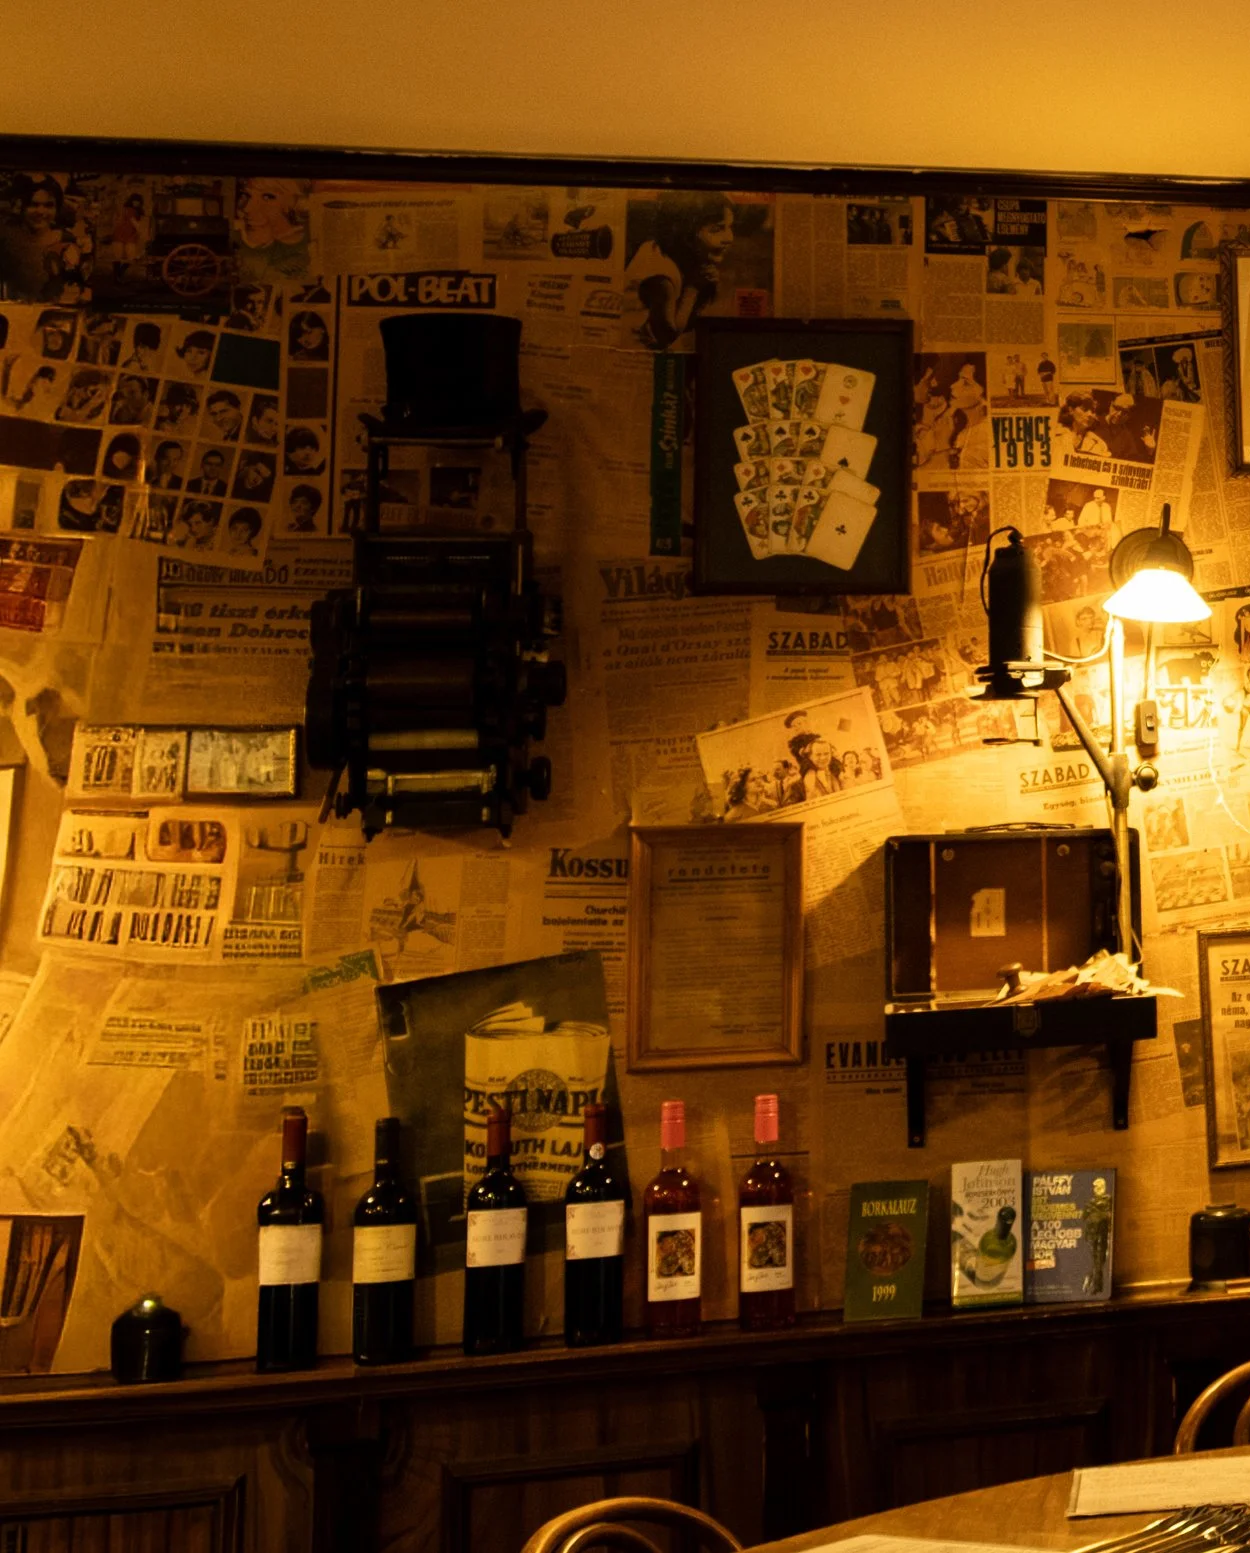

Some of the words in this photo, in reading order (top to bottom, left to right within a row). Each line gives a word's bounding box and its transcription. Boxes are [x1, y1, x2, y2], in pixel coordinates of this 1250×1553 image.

[351, 276, 493, 303] POL-BEAT
[992, 415, 1051, 442] VELENCE
[993, 440, 1051, 469] 1963
[768, 631, 848, 650] SZABAD
[1020, 763, 1089, 788] SZABAD
[465, 1139, 547, 1158] KOUTH
[978, 1164, 1009, 1179] Hugh
[963, 1175, 1016, 1190] Johnson
[862, 1197, 917, 1217] BORKALAUZ
[1032, 1229, 1081, 1240] LEGJOBB
[1043, 1220, 1062, 1230] 100
[1032, 1239, 1077, 1249] MAGYAR
[873, 1282, 899, 1303] 1999
